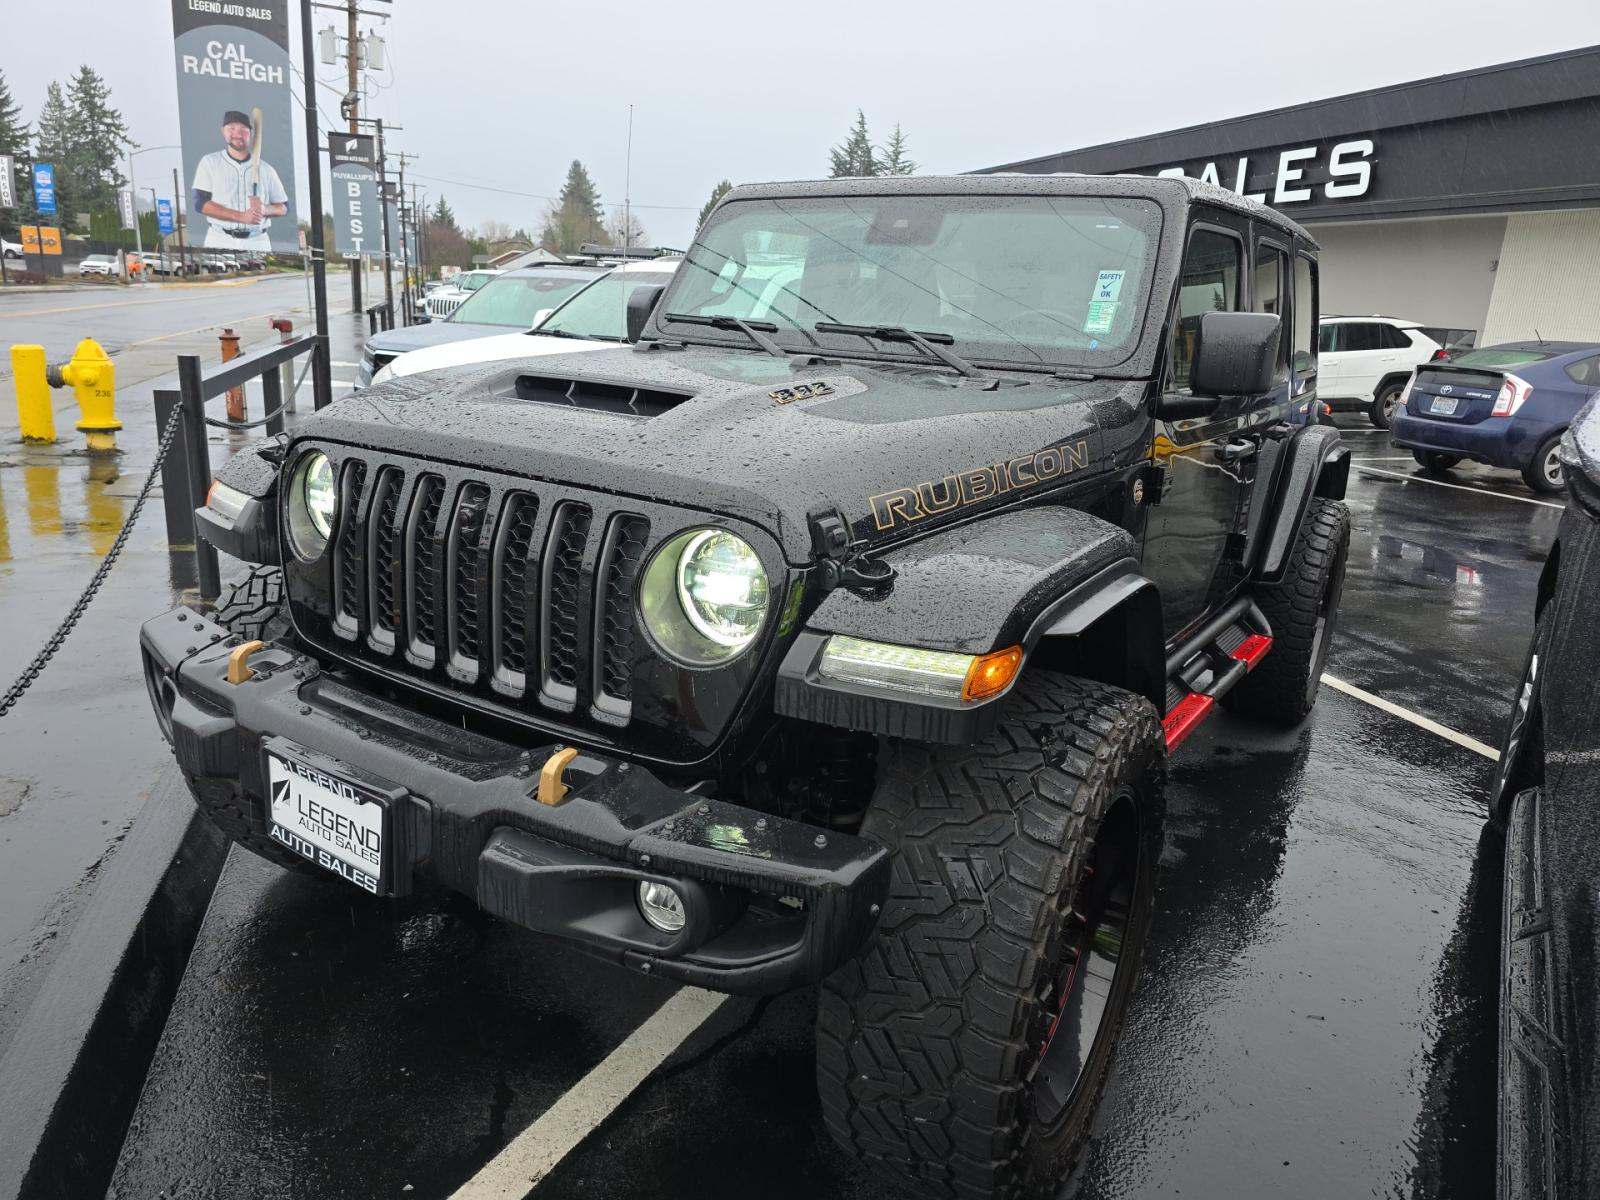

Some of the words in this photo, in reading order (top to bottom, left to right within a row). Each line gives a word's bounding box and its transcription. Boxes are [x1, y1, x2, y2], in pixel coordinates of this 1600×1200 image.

[189, 0, 221, 13] LEGEND
[223, 4, 244, 17] AUTO
[246, 8, 272, 20] SALES
[183, 55, 283, 84] RALEIGH
[206, 40, 253, 63] CAL
[347, 181, 364, 252] BEST
[1101, 290, 1111, 298] OK
[869, 441, 1089, 530] RUBICON
[288, 760, 354, 800] LEGEND
[299, 794, 381, 853] LEGEND
[299, 816, 331, 842] AUTO
[335, 836, 379, 866] SALES
[271, 824, 314, 859] AUTO
[319, 851, 377, 894] SALES
